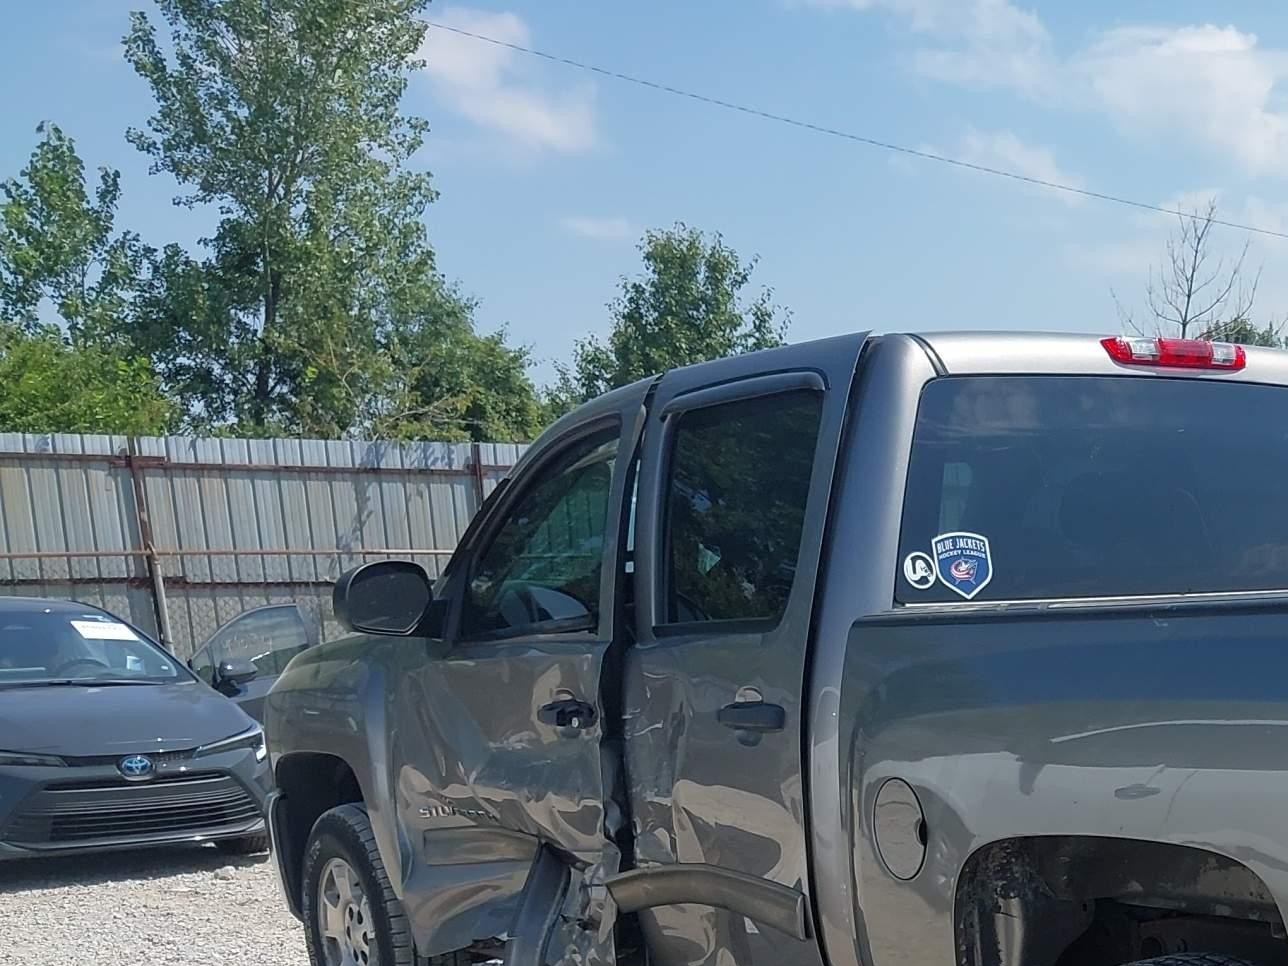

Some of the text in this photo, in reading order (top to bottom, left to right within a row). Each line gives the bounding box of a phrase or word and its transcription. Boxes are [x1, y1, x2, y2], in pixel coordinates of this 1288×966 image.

[937, 537, 985, 554] BLUE JACKETS
[938, 550, 987, 560] HOCKEY LEAGUE
